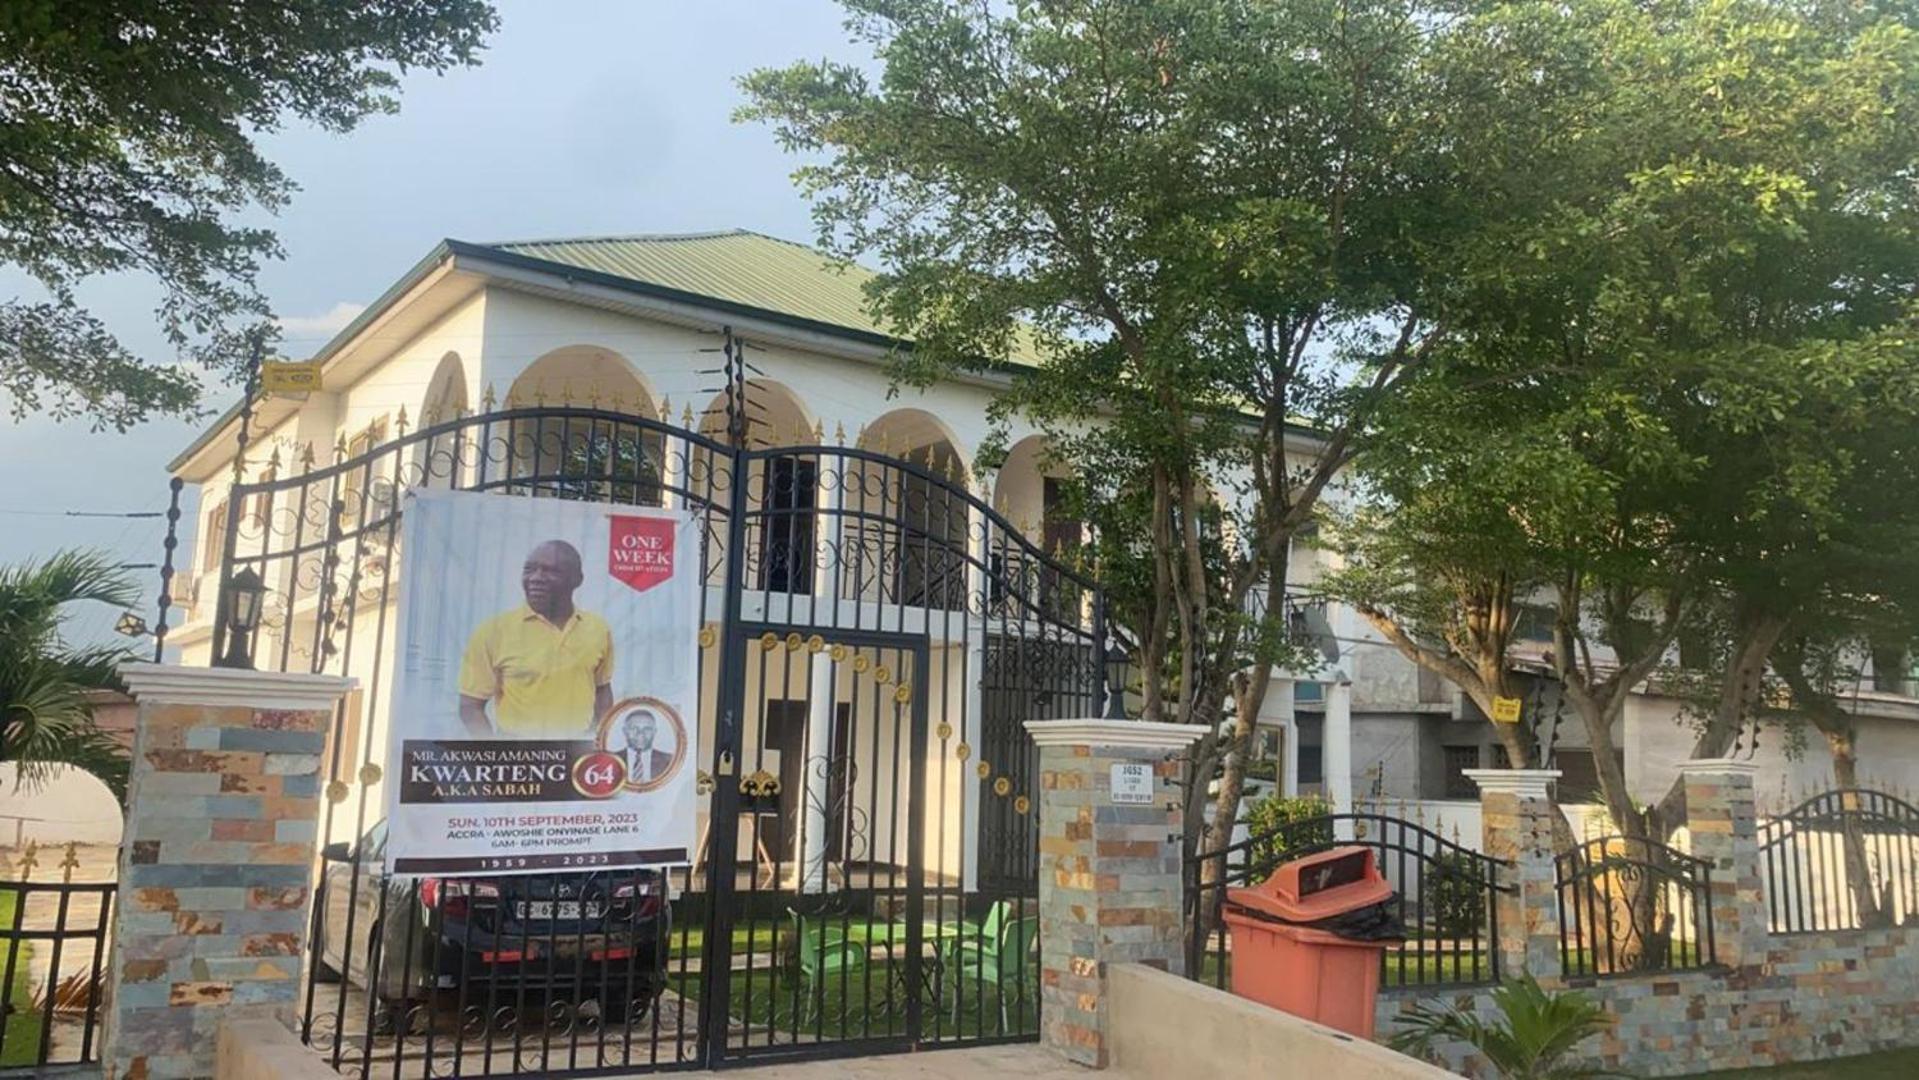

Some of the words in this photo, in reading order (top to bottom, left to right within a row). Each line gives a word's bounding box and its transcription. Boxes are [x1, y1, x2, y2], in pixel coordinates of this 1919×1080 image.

[622, 535, 662, 550] ONE
[613, 549, 671, 565] WEEK
[412, 751, 438, 762] MR.
[440, 750, 497, 762] AKWASI
[499, 749, 566, 762] AMANING
[410, 764, 566, 784] KWARTENG
[584, 764, 615, 786] 64
[431, 784, 478, 797] A.K.A
[482, 782, 542, 796] SABAH
[447, 817, 480, 829] SUN.
[484, 816, 516, 828] 10TH
[519, 814, 606, 828] SEPTEMBER,
[608, 812, 639, 824] 2023
[446, 829, 485, 840] ACCRA
[493, 827, 544, 839] AWOSHIE
[546, 826, 601, 837] ONYINASE
[603, 825, 630, 835] LANE
[521, 837, 544, 848] 6PM
[546, 836, 592, 848] PROMPT
[481, 858, 526, 869] 1959
[563, 854, 610, 866] 2023
